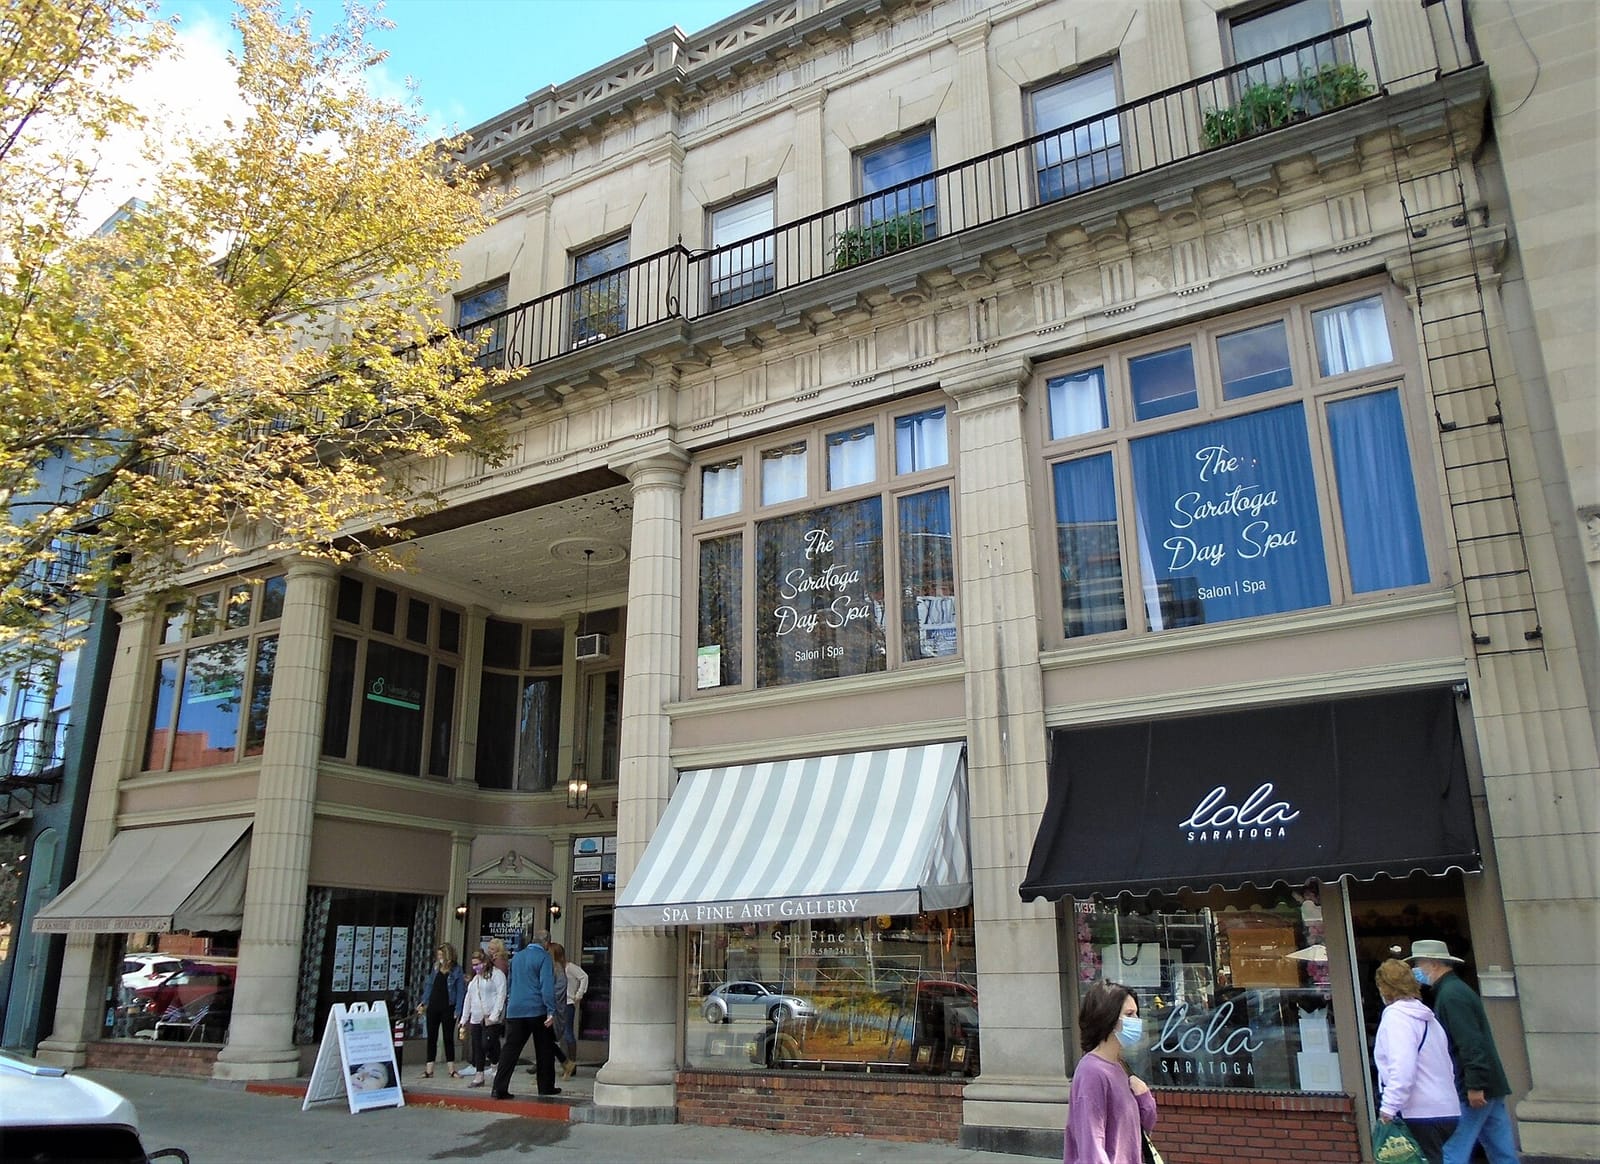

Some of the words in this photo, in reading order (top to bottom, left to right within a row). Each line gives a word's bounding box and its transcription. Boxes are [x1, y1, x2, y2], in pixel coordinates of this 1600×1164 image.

[1195, 444, 1239, 482] The
[1169, 484, 1278, 529] Saratoga
[803, 527, 834, 560] The
[1163, 536, 1226, 573] Day
[1236, 520, 1298, 559] Spa
[780, 563, 859, 600] Saratoga
[1197, 584, 1232, 600] Salon
[1242, 579, 1267, 594] Spa
[773, 605, 819, 638] Day
[825, 595, 870, 628] Spa
[794, 649, 820, 662] Salon
[827, 645, 844, 659] Spa
[1178, 782, 1300, 828] lola
[1187, 826, 1286, 841] SARATOGA
[662, 906, 690, 922] SPA
[696, 905, 734, 920] FINE
[741, 903, 775, 918] ART
[780, 898, 859, 917] GALLERY
[773, 931, 801, 948] Spa
[809, 930, 846, 944] Fine
[1150, 1001, 1264, 1056] lola
[1161, 1060, 1255, 1075] SARATOGA
